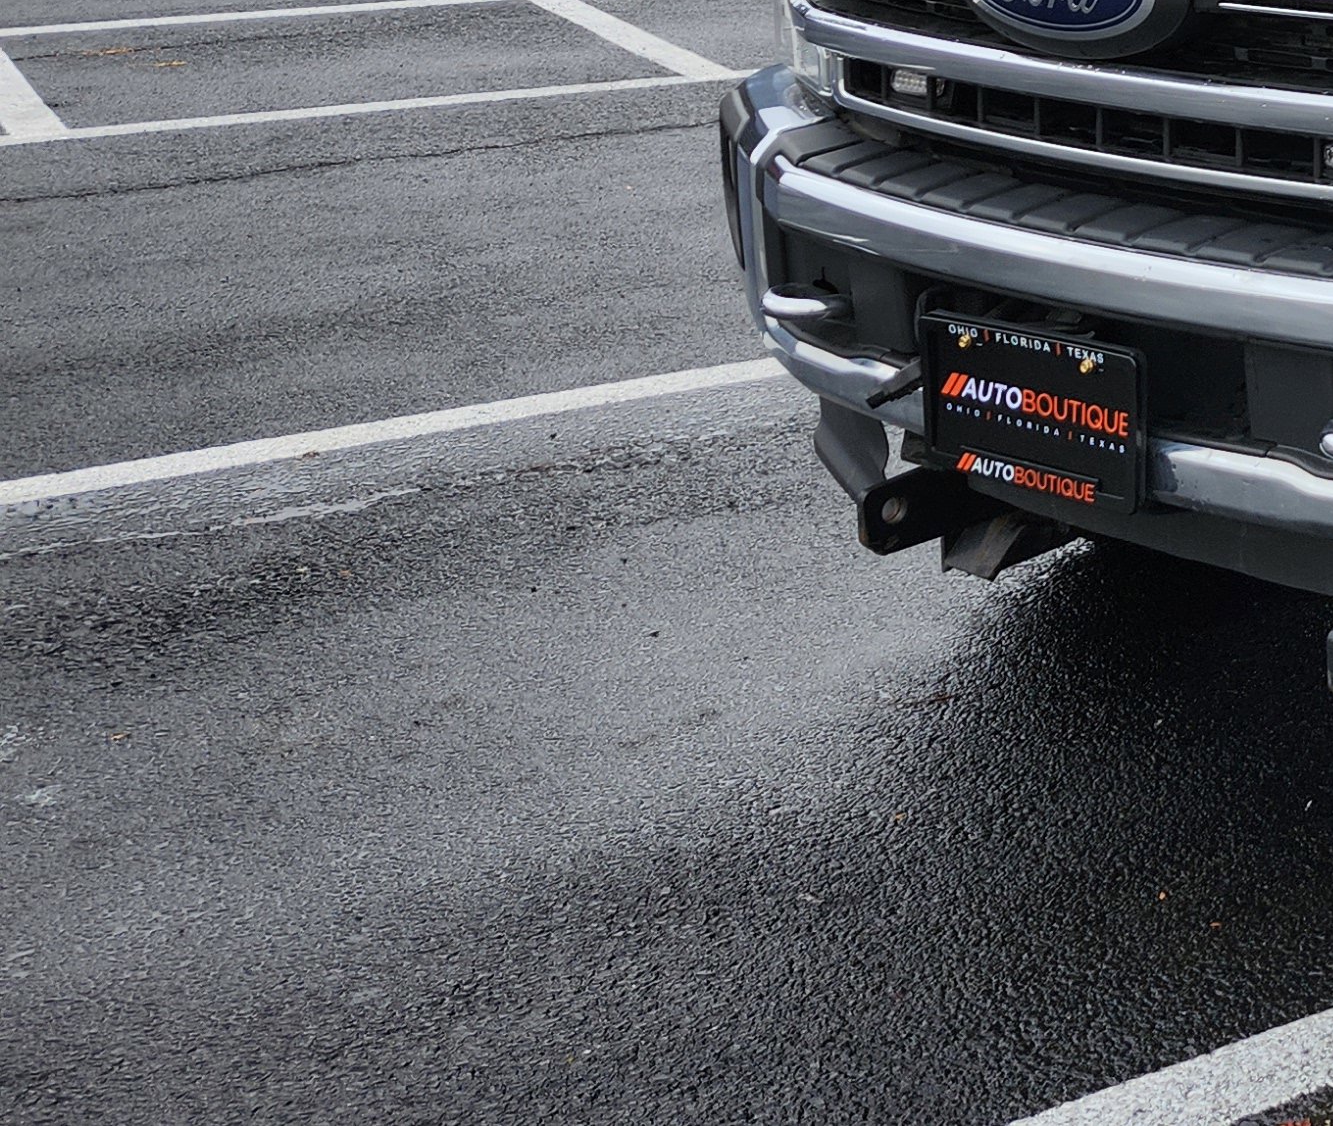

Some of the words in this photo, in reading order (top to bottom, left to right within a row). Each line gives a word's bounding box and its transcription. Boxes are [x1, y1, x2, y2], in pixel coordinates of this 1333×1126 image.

[948, 324, 979, 338] OHIO
[995, 332, 1051, 353] FLORIDA
[1066, 346, 1105, 364] TEXAS
[946, 402, 980, 418] OHIO
[997, 414, 1060, 437] FLORIDA
[1080, 434, 1126, 454] TEXAS
